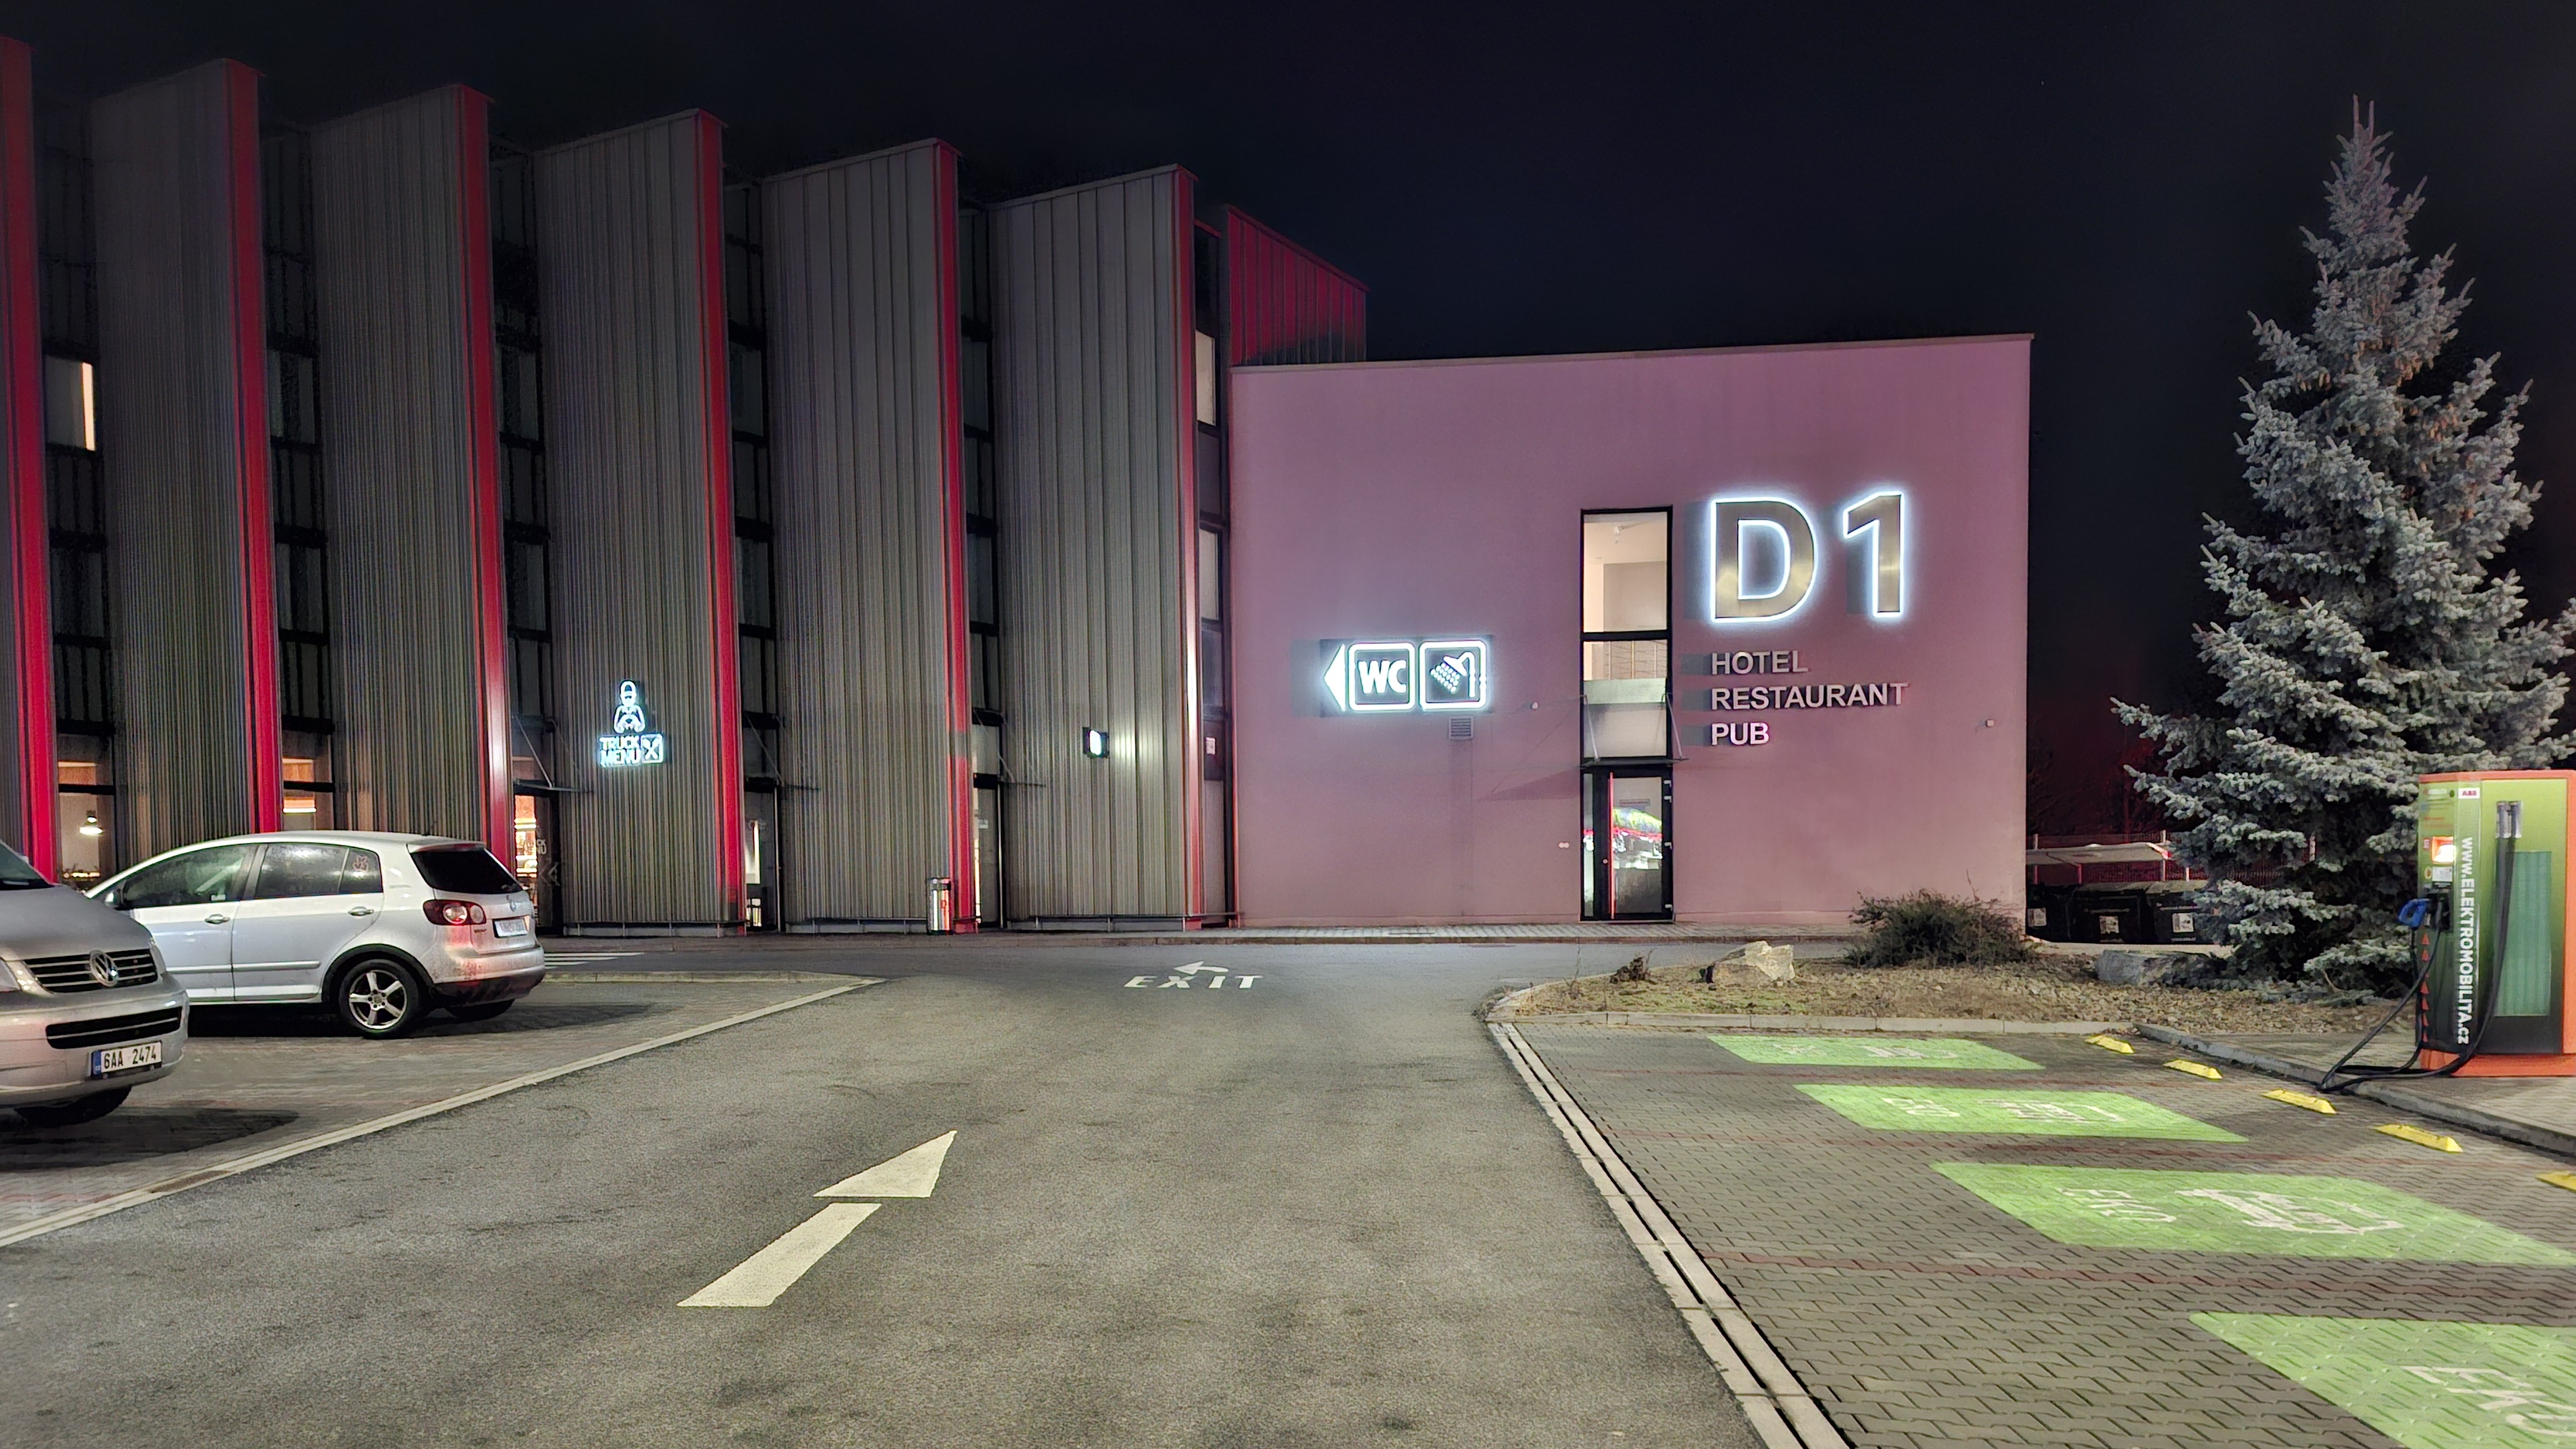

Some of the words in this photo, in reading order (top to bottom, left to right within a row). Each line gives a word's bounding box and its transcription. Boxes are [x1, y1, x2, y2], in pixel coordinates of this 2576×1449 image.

[1709, 492, 1906, 622] D1
[1711, 650, 1809, 675] HOTEL
[1357, 660, 1407, 694] WC
[1711, 683, 1908, 710] RESTAURANT
[600, 736, 640, 751] TRUCK
[1711, 722, 1770, 746] PUB
[600, 748, 641, 766] MENU
[1123, 975, 1263, 989] EXIT
[104, 1051, 123, 1069] 6AA
[132, 1045, 156, 1065] 2474
